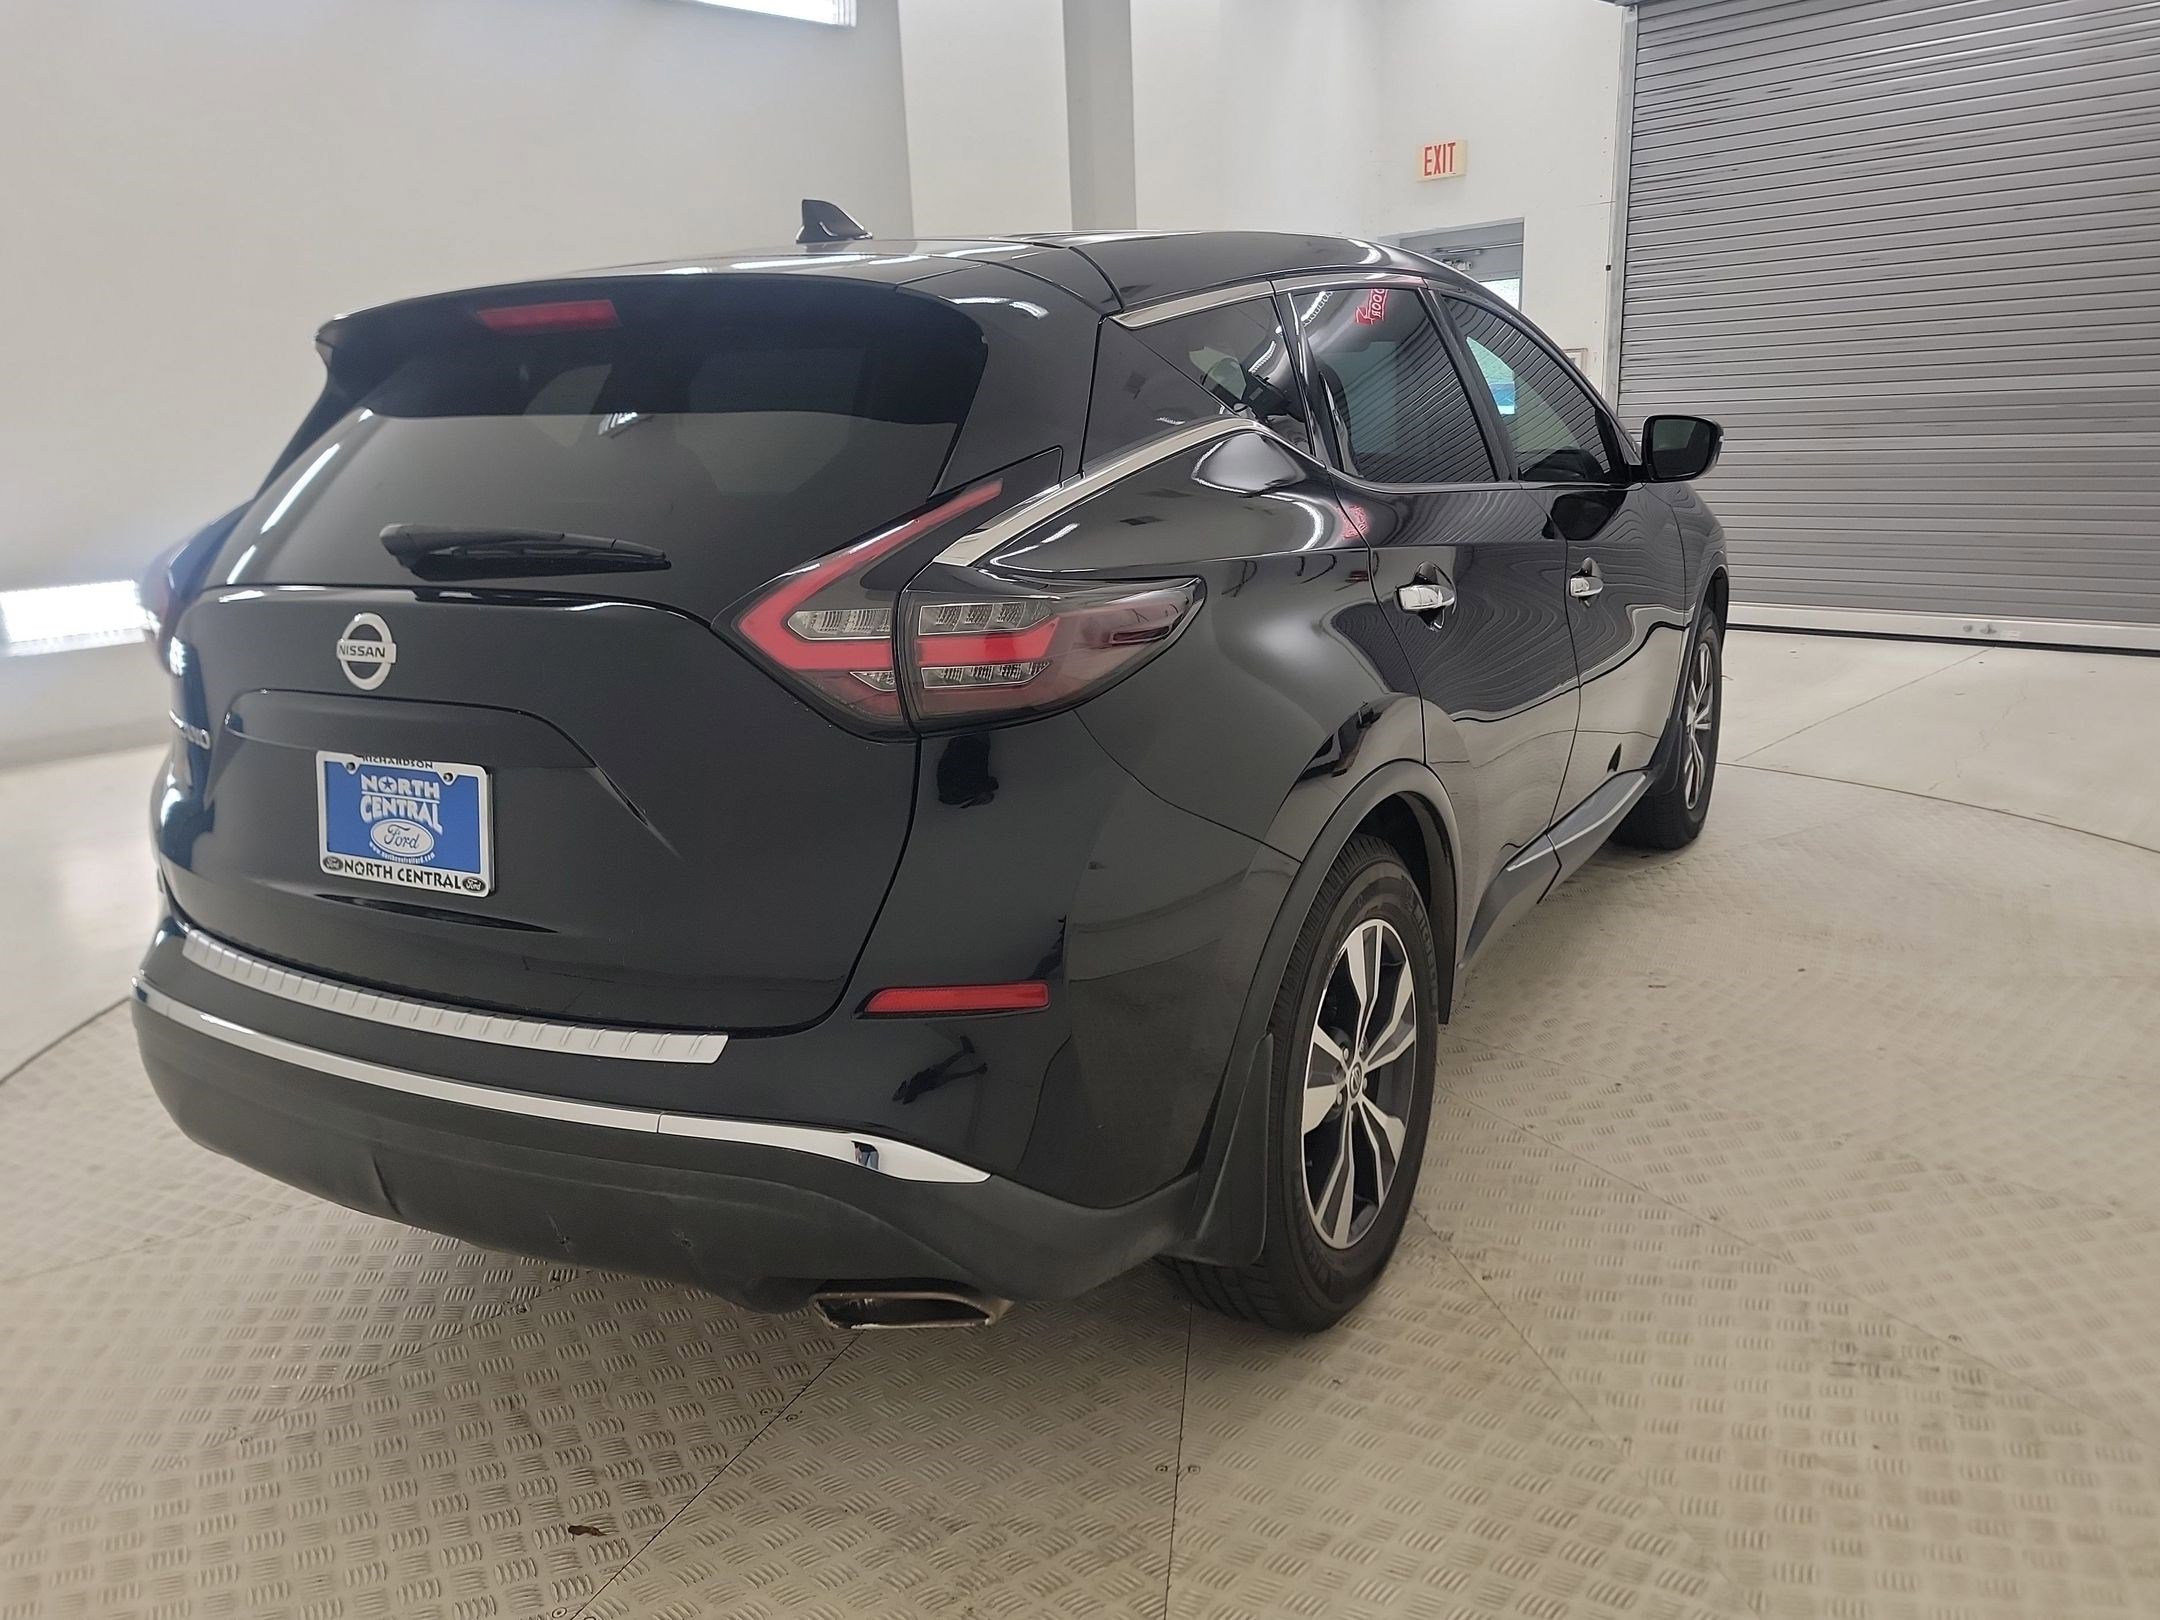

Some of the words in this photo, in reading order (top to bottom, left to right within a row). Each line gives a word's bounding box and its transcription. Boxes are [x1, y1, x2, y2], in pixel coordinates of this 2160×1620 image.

[1424, 142, 1456, 176] EXIT
[340, 645, 385, 658] NISSAN
[361, 774, 440, 799] NORTH
[360, 796, 442, 835] CENTRAL
[384, 825, 420, 849] Ford
[344, 859, 393, 880] NORTH
[397, 868, 462, 890] CENTRAL
